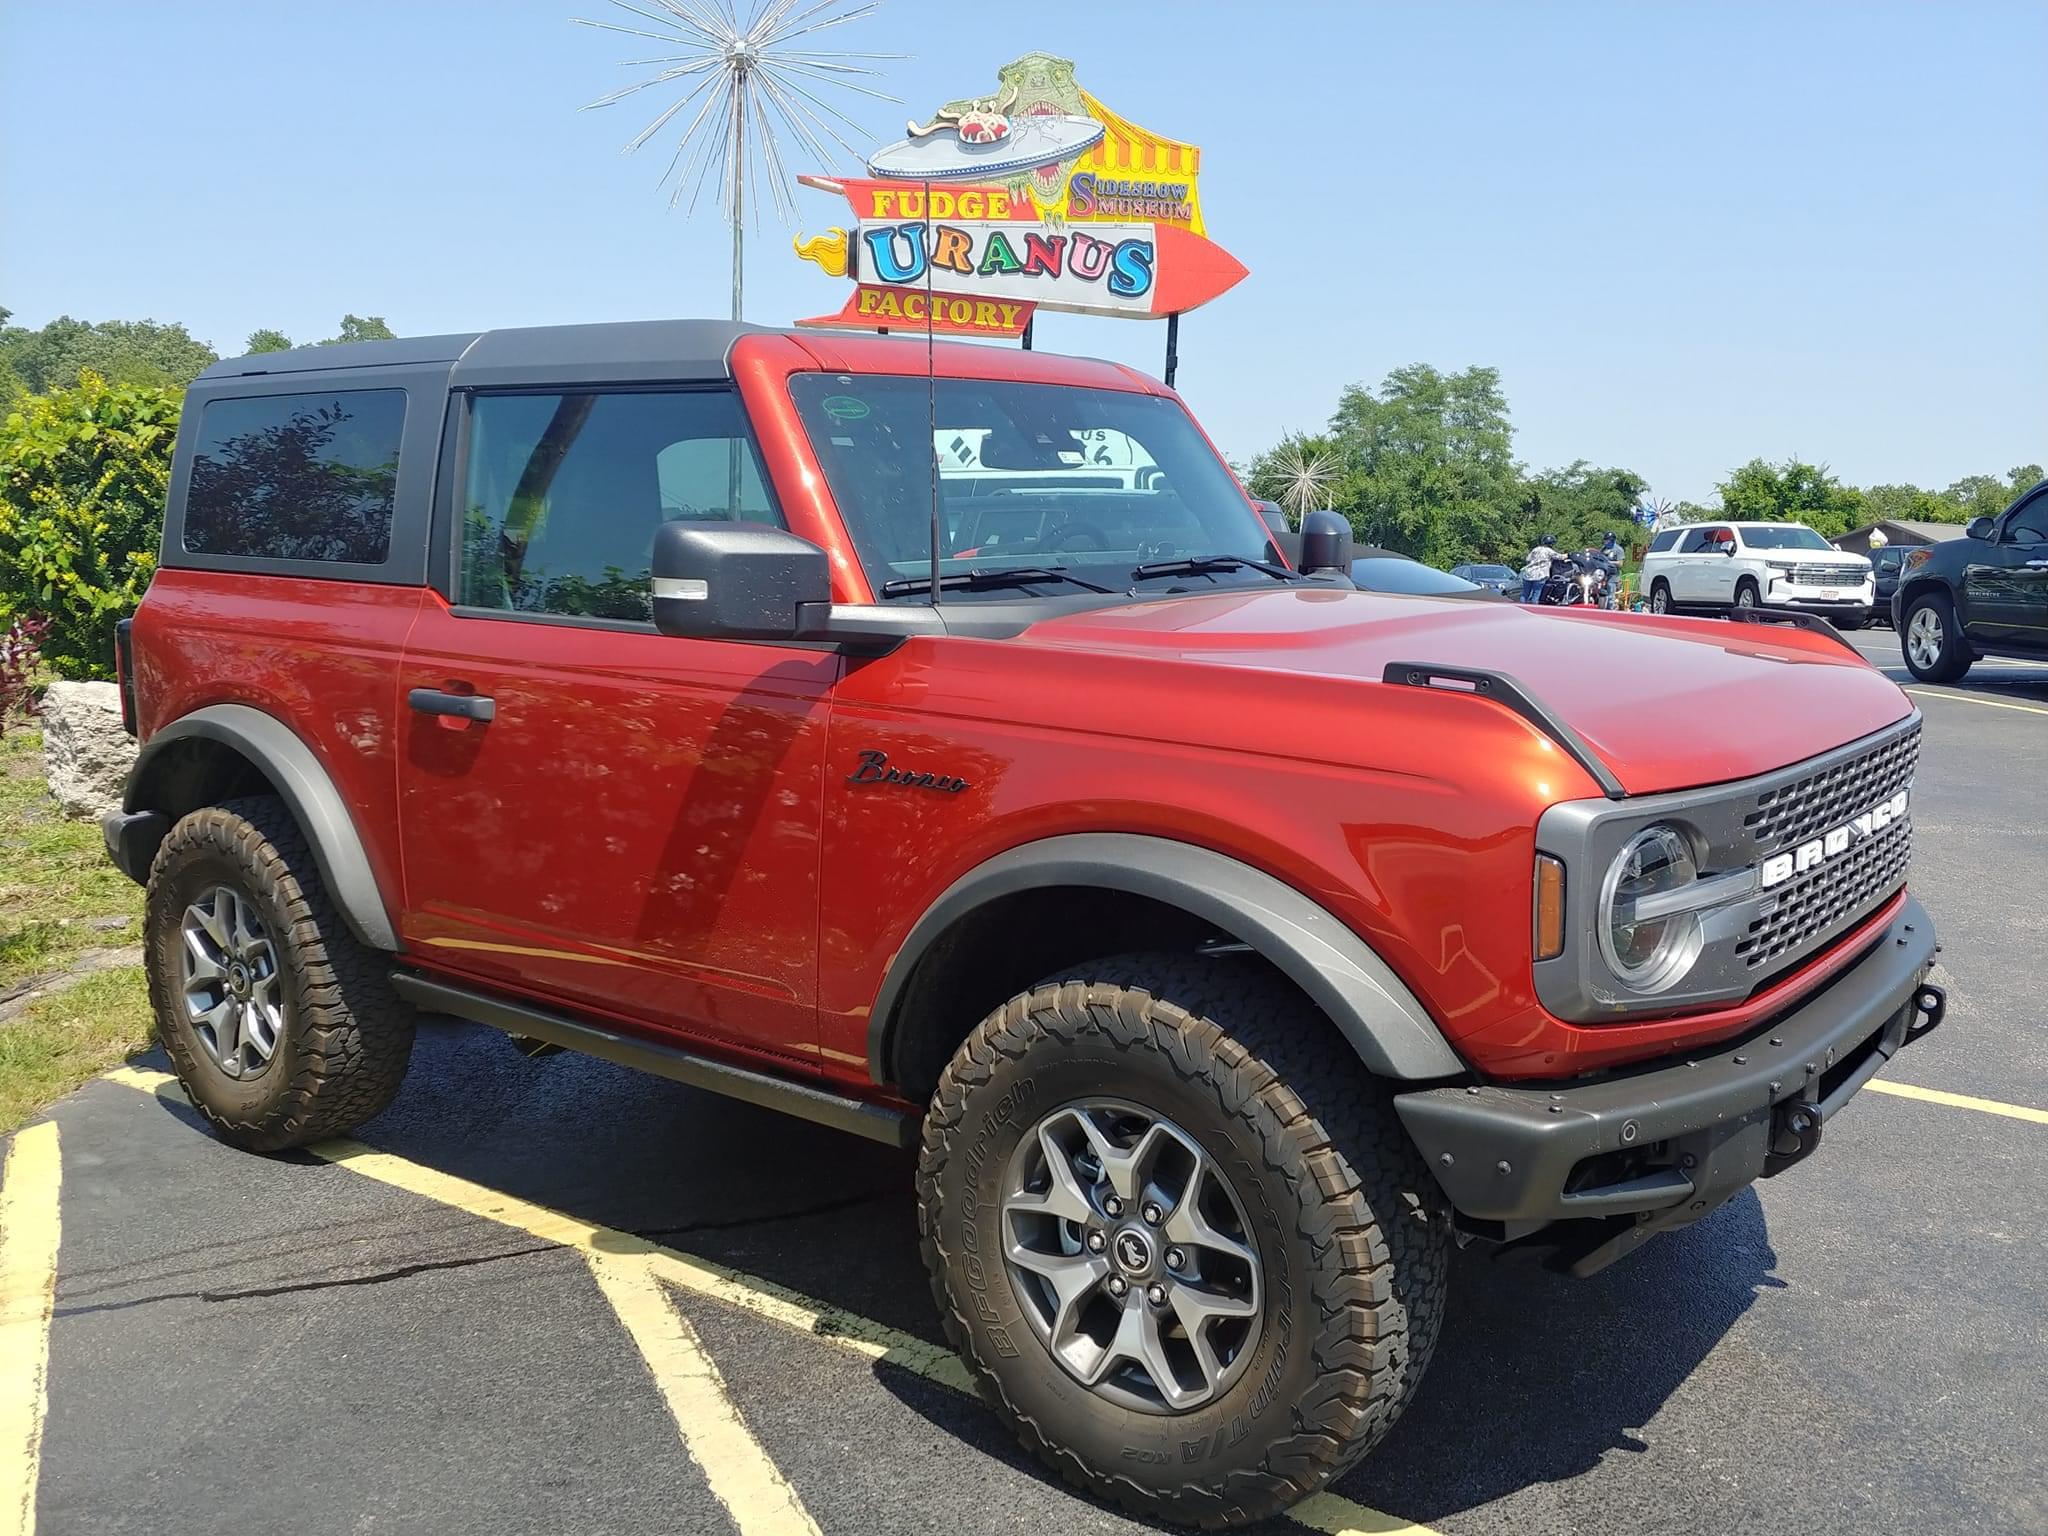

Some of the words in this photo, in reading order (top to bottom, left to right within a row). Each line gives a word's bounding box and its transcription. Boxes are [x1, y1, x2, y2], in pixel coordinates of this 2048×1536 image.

[872, 190, 1010, 219] FUDGE
[1069, 172, 1188, 217] SIDESHOW
[1095, 198, 1193, 219] MUSEUM
[864, 222, 1153, 296] URANUS
[858, 289, 1022, 329] FACTORY
[1081, 431, 1106, 441] US
[847, 749, 971, 793] Bronco
[1761, 790, 1908, 888] BRONCO
[961, 1076, 1036, 1359] BFGoodrich
